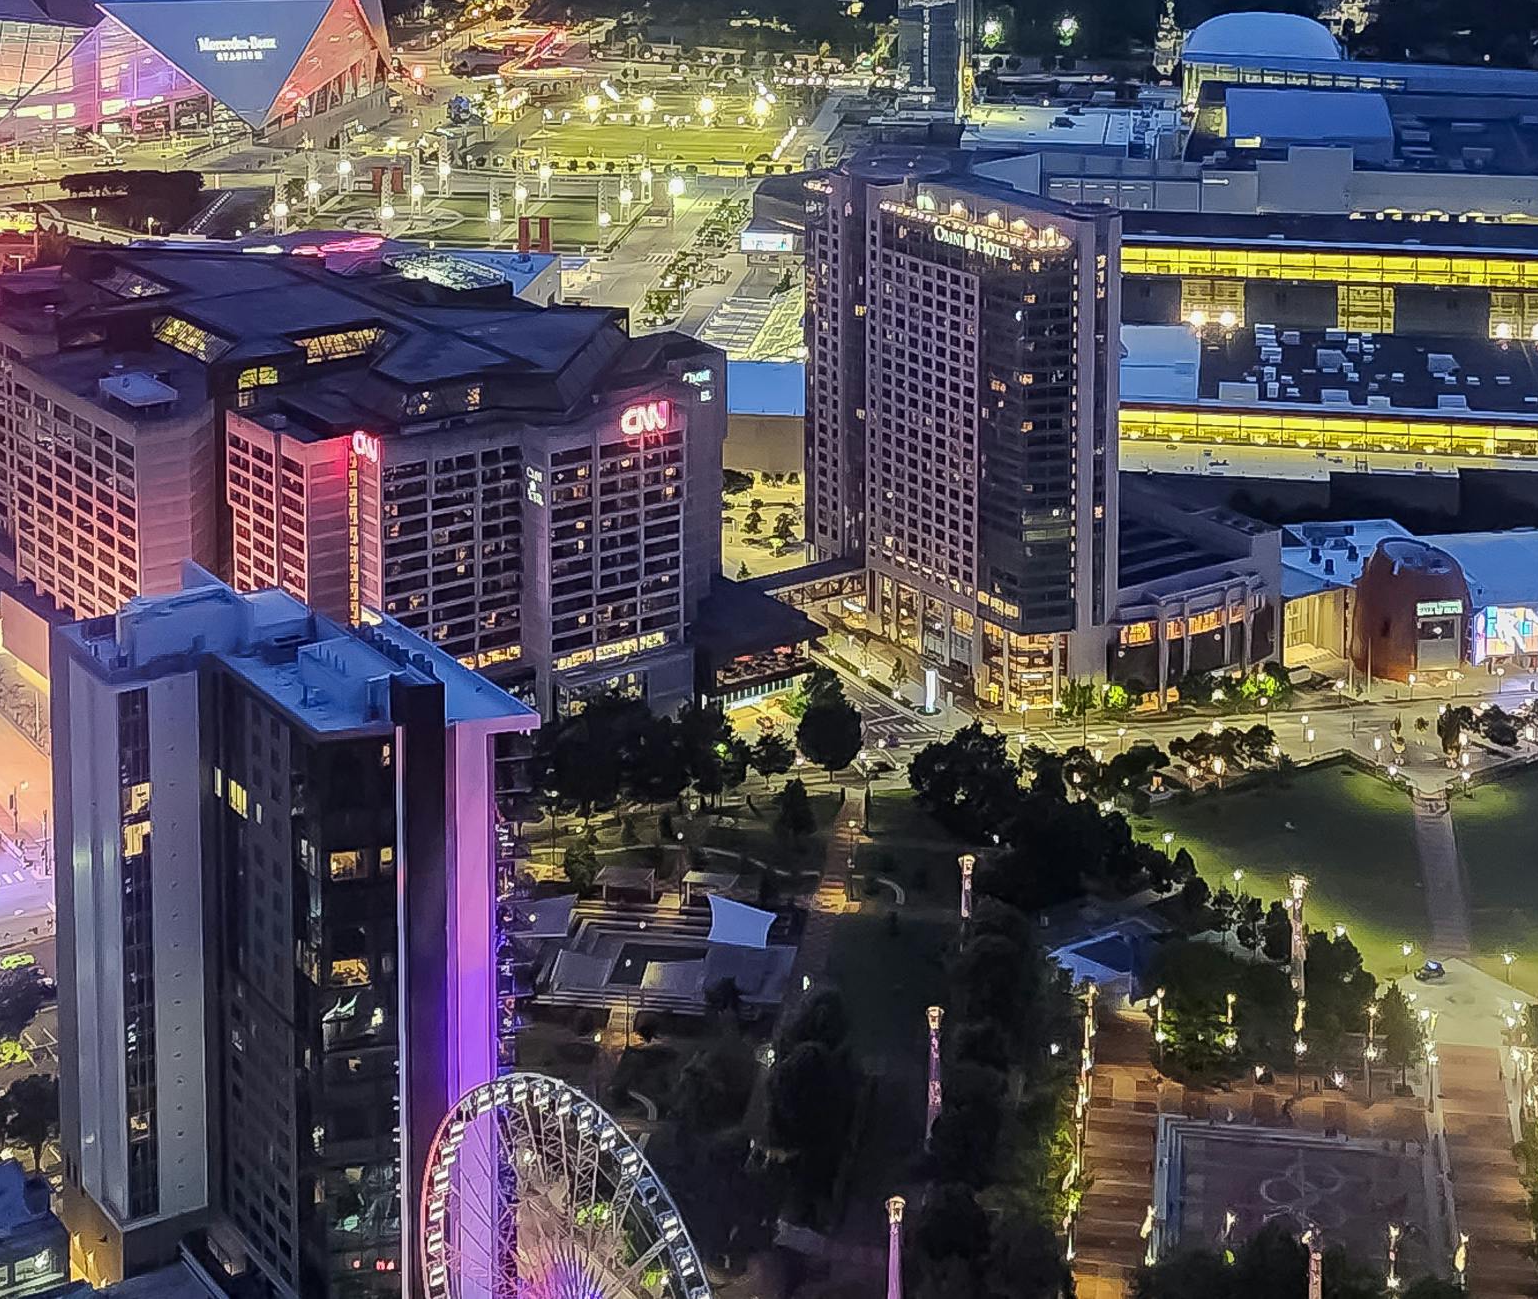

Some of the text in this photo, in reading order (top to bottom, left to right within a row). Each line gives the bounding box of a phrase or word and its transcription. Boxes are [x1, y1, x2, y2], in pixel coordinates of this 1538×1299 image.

[197, 36, 277, 52] Mercedes-Benz
[934, 225, 1013, 260] OMNI HOTEL
[621, 400, 670, 435] CNN
